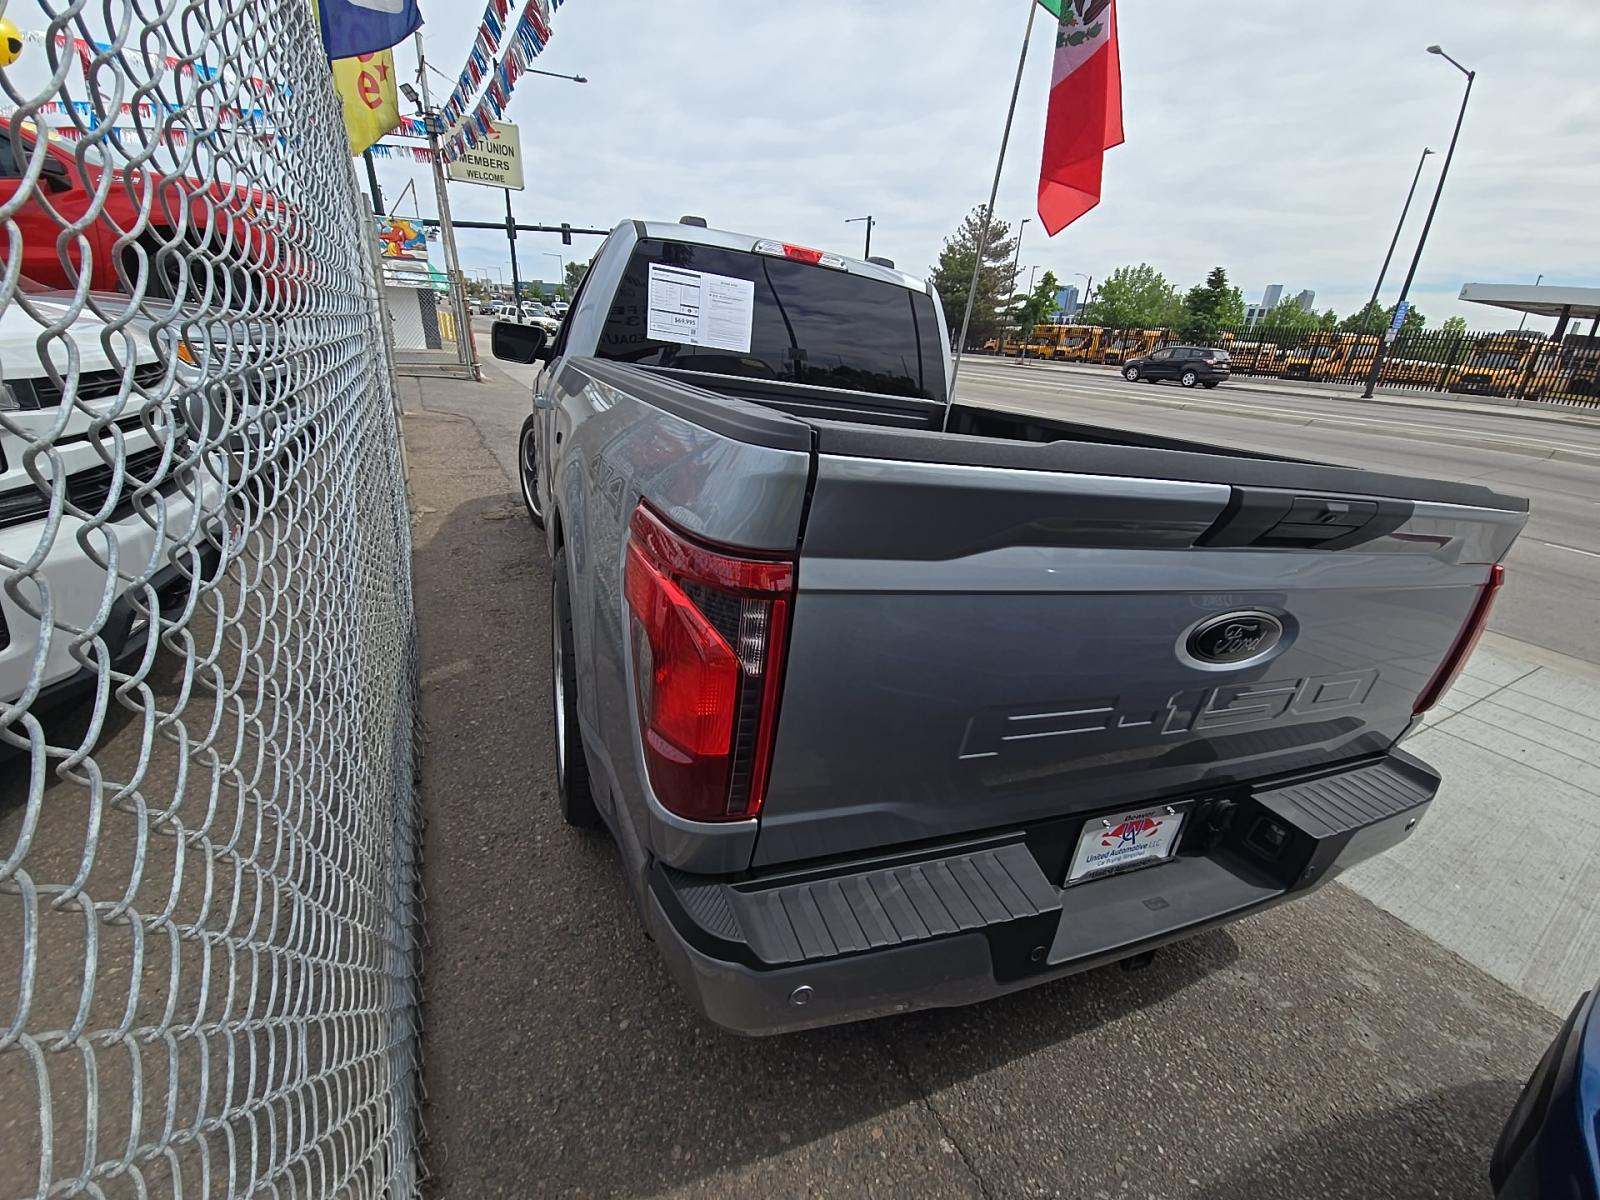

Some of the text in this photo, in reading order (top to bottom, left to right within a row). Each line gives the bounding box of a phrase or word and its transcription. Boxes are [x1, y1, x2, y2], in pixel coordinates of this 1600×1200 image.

[486, 141, 515, 158] UNION
[459, 153, 510, 171] MEMBERS
[466, 168, 505, 183] WELCOME
[1213, 623, 1268, 656] Ford
[958, 668, 1380, 760] F-150
[1086, 850, 1109, 863] United
[1109, 842, 1148, 858] Automotive
